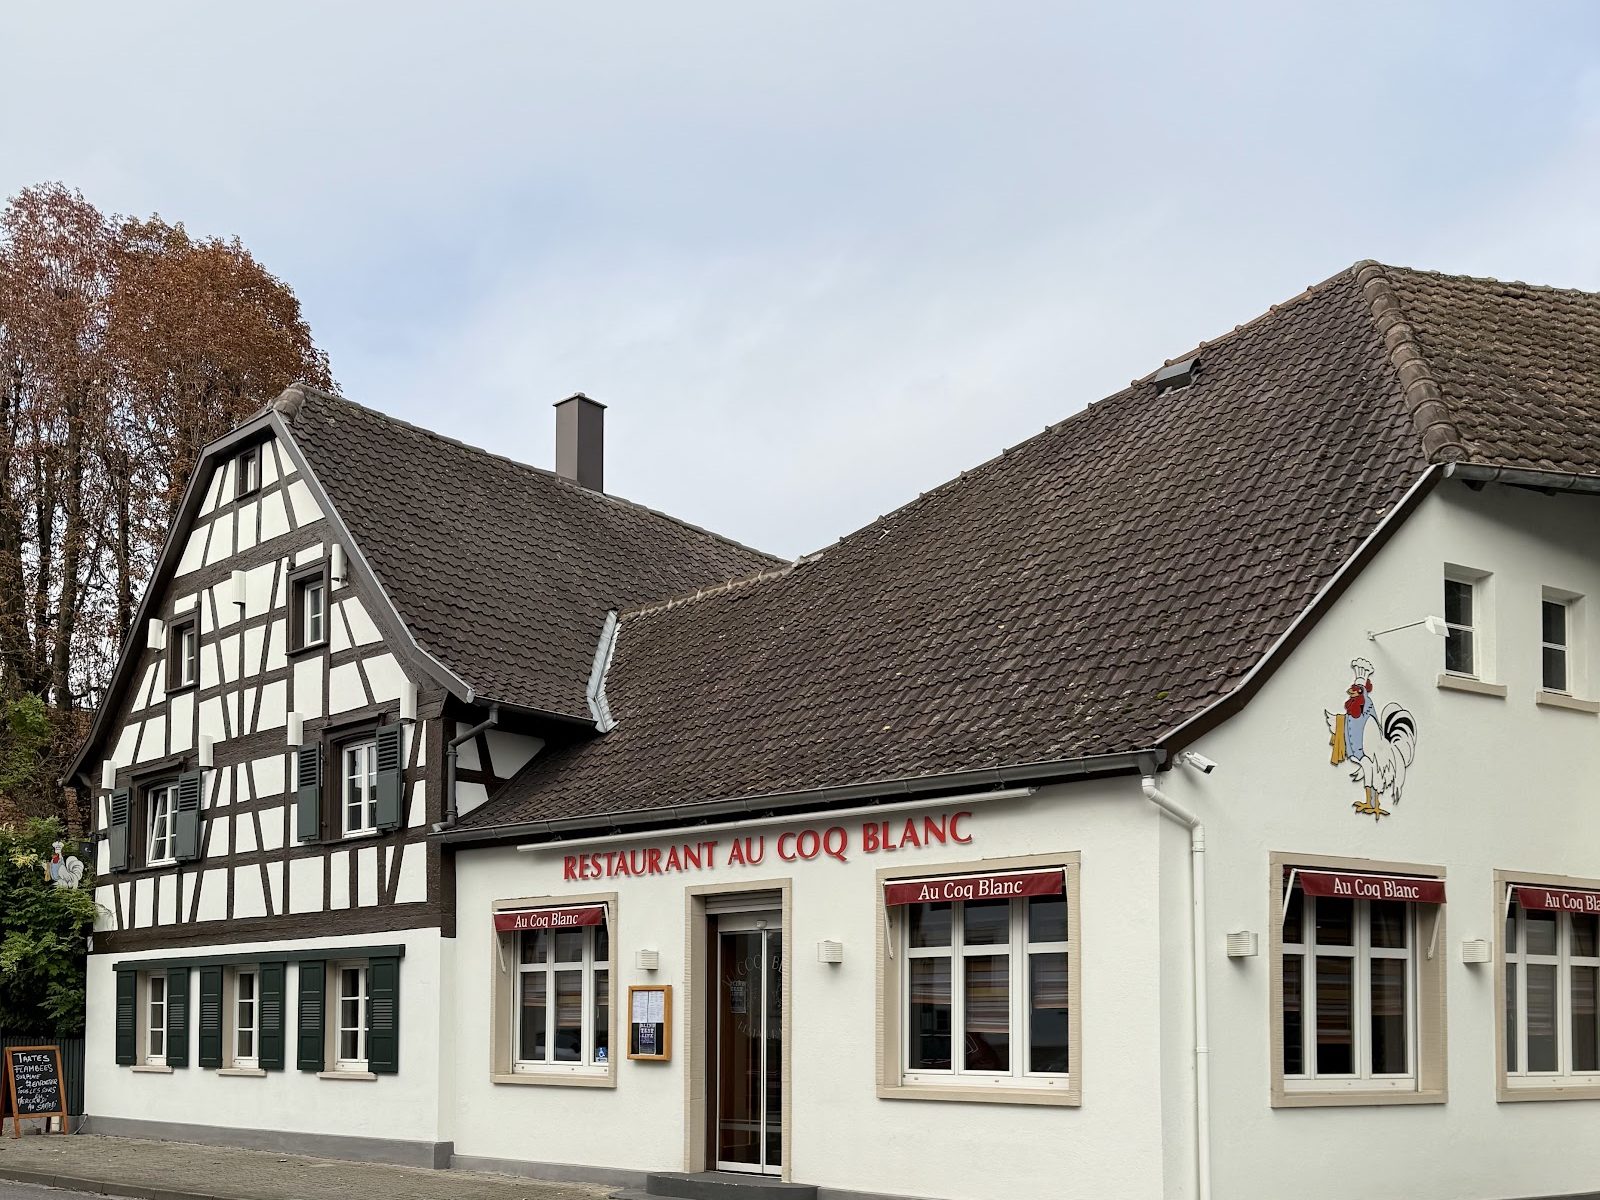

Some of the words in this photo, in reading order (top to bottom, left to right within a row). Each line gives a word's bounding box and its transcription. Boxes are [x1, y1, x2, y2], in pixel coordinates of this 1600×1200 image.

[564, 841, 718, 880] RESTAURANT
[728, 836, 764, 865] AU
[777, 827, 848, 862] COQ
[863, 812, 973, 852] BLANC
[918, 884, 939, 900] Au
[944, 883, 973, 899] Coq
[978, 879, 1023, 896] Blanc
[1333, 877, 1352, 894] Au
[1355, 879, 1381, 899] Coq
[1383, 880, 1420, 898] Blanc
[1545, 892, 1560, 908] Au
[1562, 893, 1584, 912] Coq
[514, 915, 527, 928] Au
[530, 914, 548, 928] Coq
[551, 912, 578, 926] Blanc
